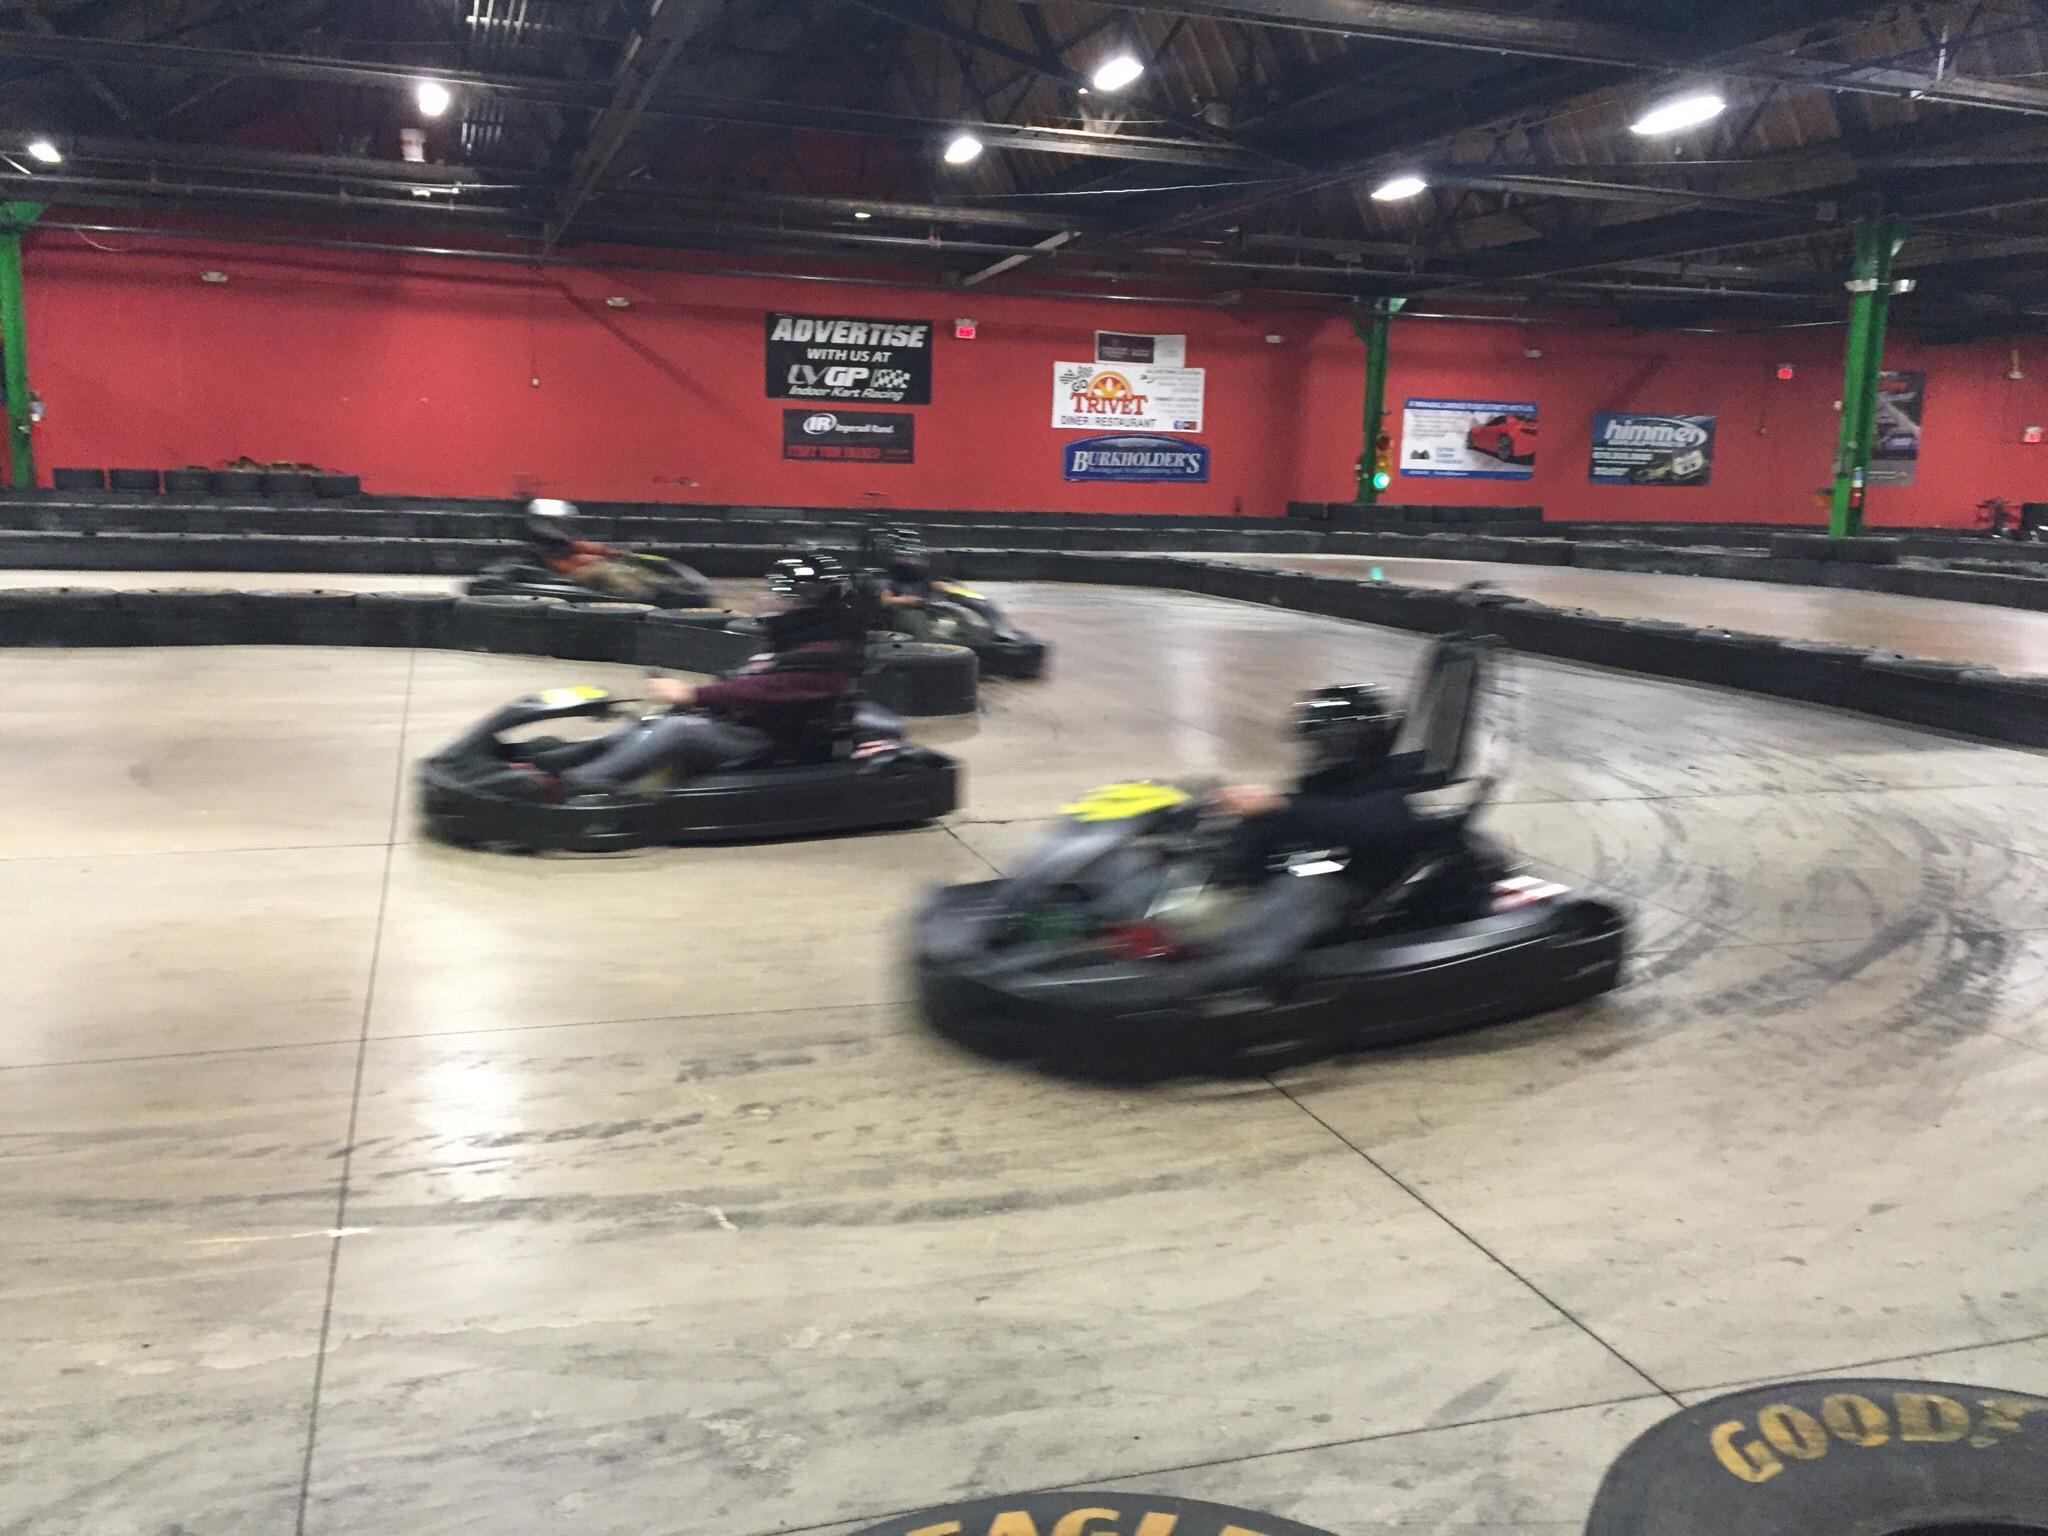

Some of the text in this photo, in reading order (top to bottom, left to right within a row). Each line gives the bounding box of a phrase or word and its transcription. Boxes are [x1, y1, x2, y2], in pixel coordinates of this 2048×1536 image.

[770, 318, 928, 348] ADVERTISE
[806, 348, 892, 363] WITH US AT
[788, 386, 904, 402] Indoor Kart Racing
[1070, 392, 1148, 415] TRIVET
[1071, 451, 1202, 474] BURKHOLDER'S
